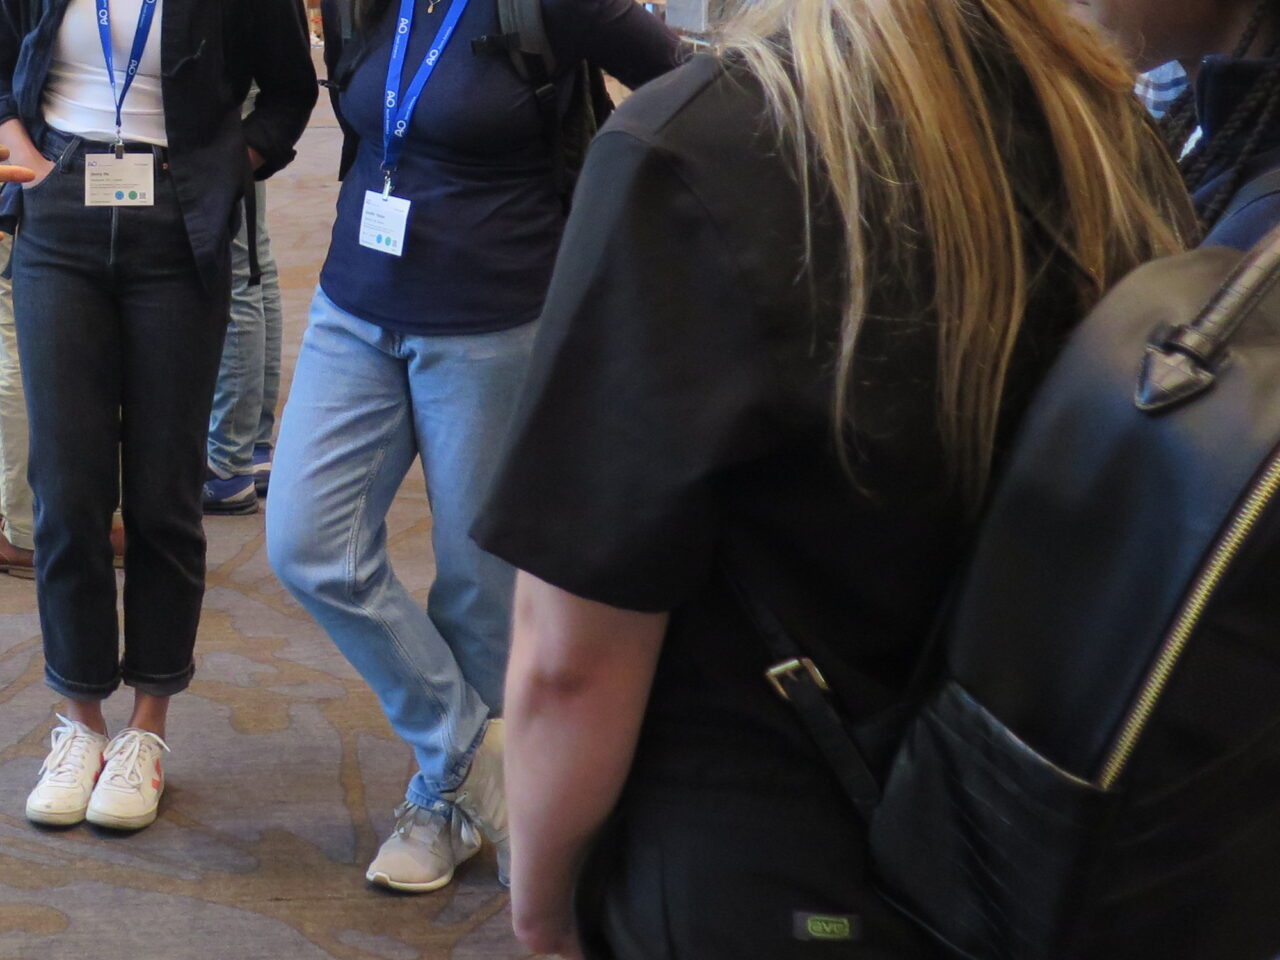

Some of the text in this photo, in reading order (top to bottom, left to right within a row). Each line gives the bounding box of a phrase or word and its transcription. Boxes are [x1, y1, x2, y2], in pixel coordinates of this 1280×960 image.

[99, 9, 109, 25] AO
[398, 17, 409, 34] AO
[426, 49, 439, 66] AO
[128, 59, 138, 76] AO
[386, 90, 396, 108] AO
[394, 120, 406, 137] AO
